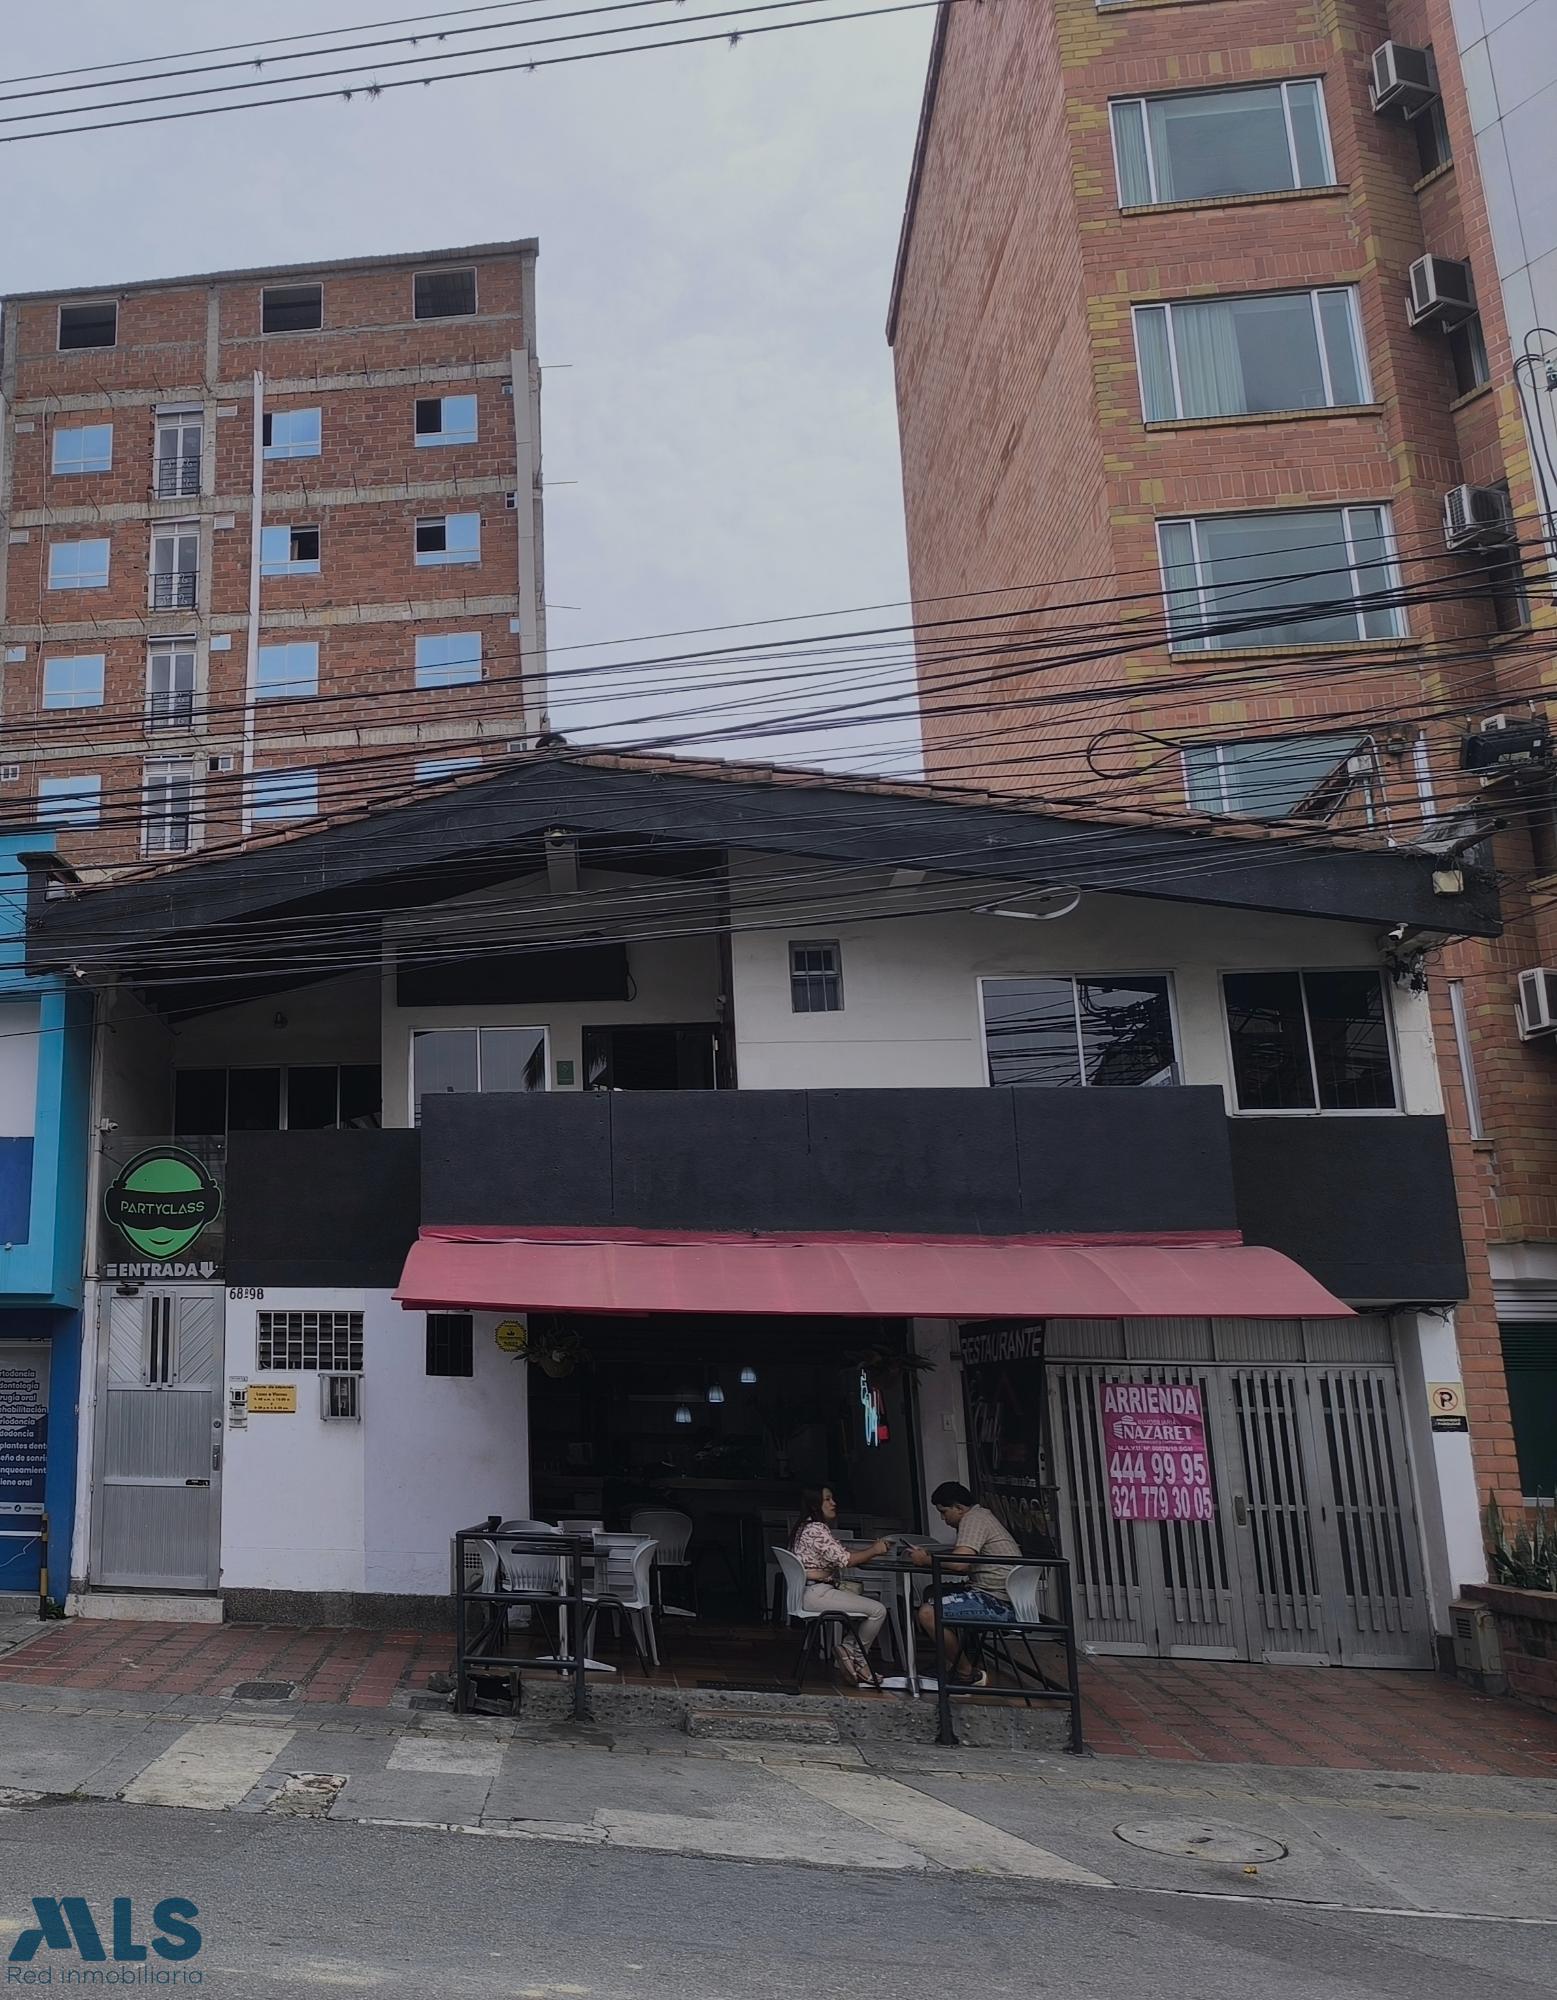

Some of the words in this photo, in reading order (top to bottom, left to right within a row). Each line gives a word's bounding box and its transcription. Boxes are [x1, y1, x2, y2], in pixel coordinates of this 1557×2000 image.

[120, 1200, 205, 1215] PARTYCLASS
[119, 1263, 199, 1277] ENTRADA
[961, 1325, 1042, 1365] RESTAURANTE
[21, 1393, 36, 1401] oral
[1104, 1386, 1199, 1415] ARRIENDA
[1439, 1391, 1453, 1408] P
[1123, 1425, 1193, 1441] NAZARET
[1110, 1451, 1147, 1484] 444
[1151, 1452, 1176, 1485] 99
[1181, 1453, 1207, 1486] 95
[17, 1478, 33, 1486] oral
[1111, 1485, 1138, 1518] 321
[1141, 1486, 1169, 1519] 779
[1172, 1486, 1191, 1519] 30
[1194, 1486, 1213, 1519] 05
